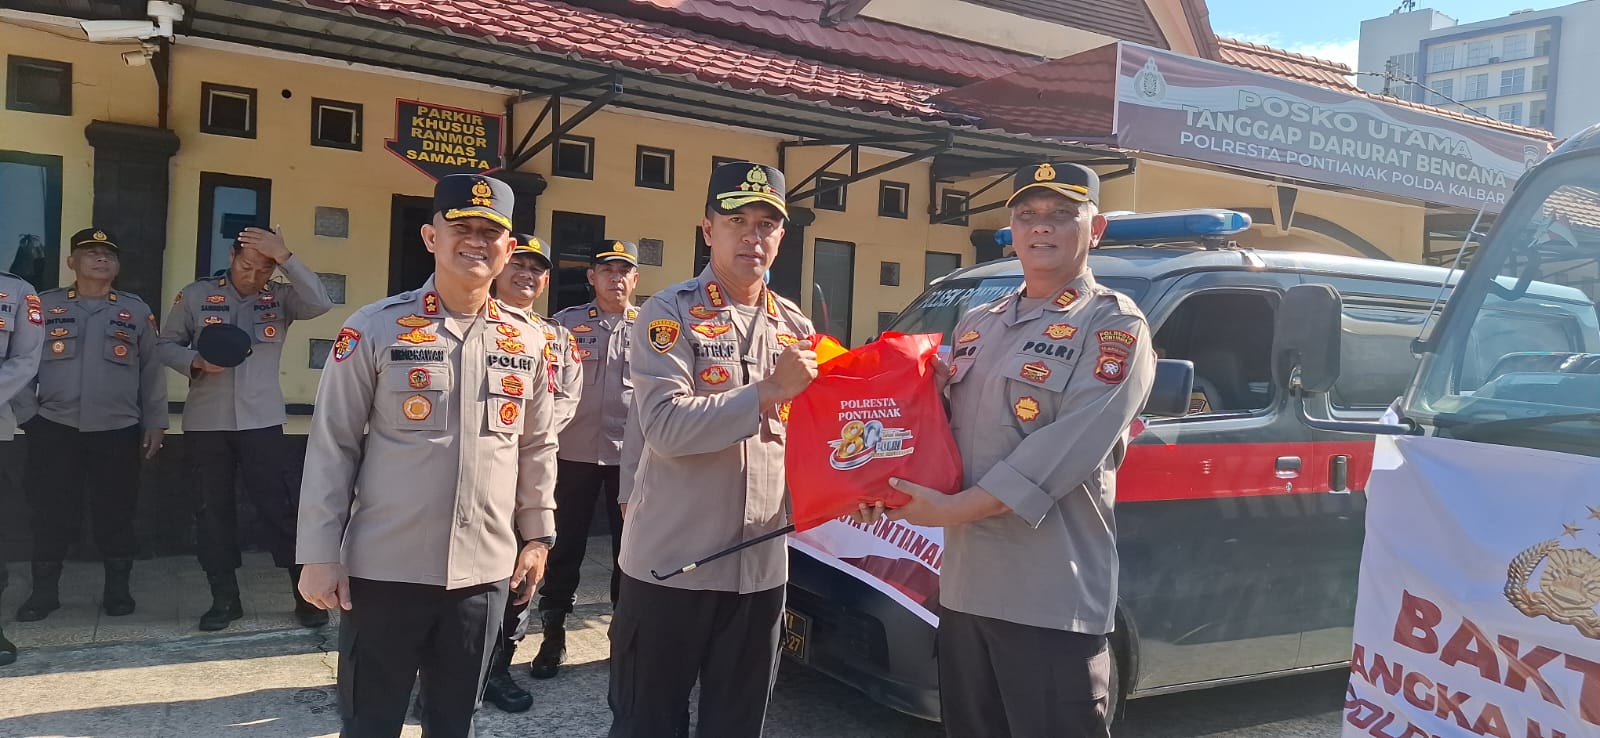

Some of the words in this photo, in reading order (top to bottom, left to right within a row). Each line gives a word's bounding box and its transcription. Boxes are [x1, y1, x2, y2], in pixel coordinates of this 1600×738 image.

[412, 116, 486, 136] KHUSUS
[417, 105, 483, 126] PARKIR
[1238, 89, 1358, 132] POSKO
[1368, 119, 1472, 160] UTAMA
[411, 127, 487, 148] RANMOR
[1182, 104, 1303, 145] TANGGAP
[1309, 130, 1412, 168] DARURAT
[1416, 154, 1507, 188] BENCANA
[422, 140, 476, 157] DINAS
[406, 149, 490, 170] SAMAPTA
[1180, 131, 1281, 162] POLRESTA
[1286, 150, 1388, 182] PONTIANAK
[1392, 172, 1445, 193] POLDA
[1450, 183, 1505, 204] KALBAR
[1022, 341, 1075, 361] POLRI
[486, 353, 532, 372] POLRI
[840, 397, 897, 410] POLRESTA
[838, 408, 902, 421] PONTIANAK
[837, 420, 884, 459] 80
